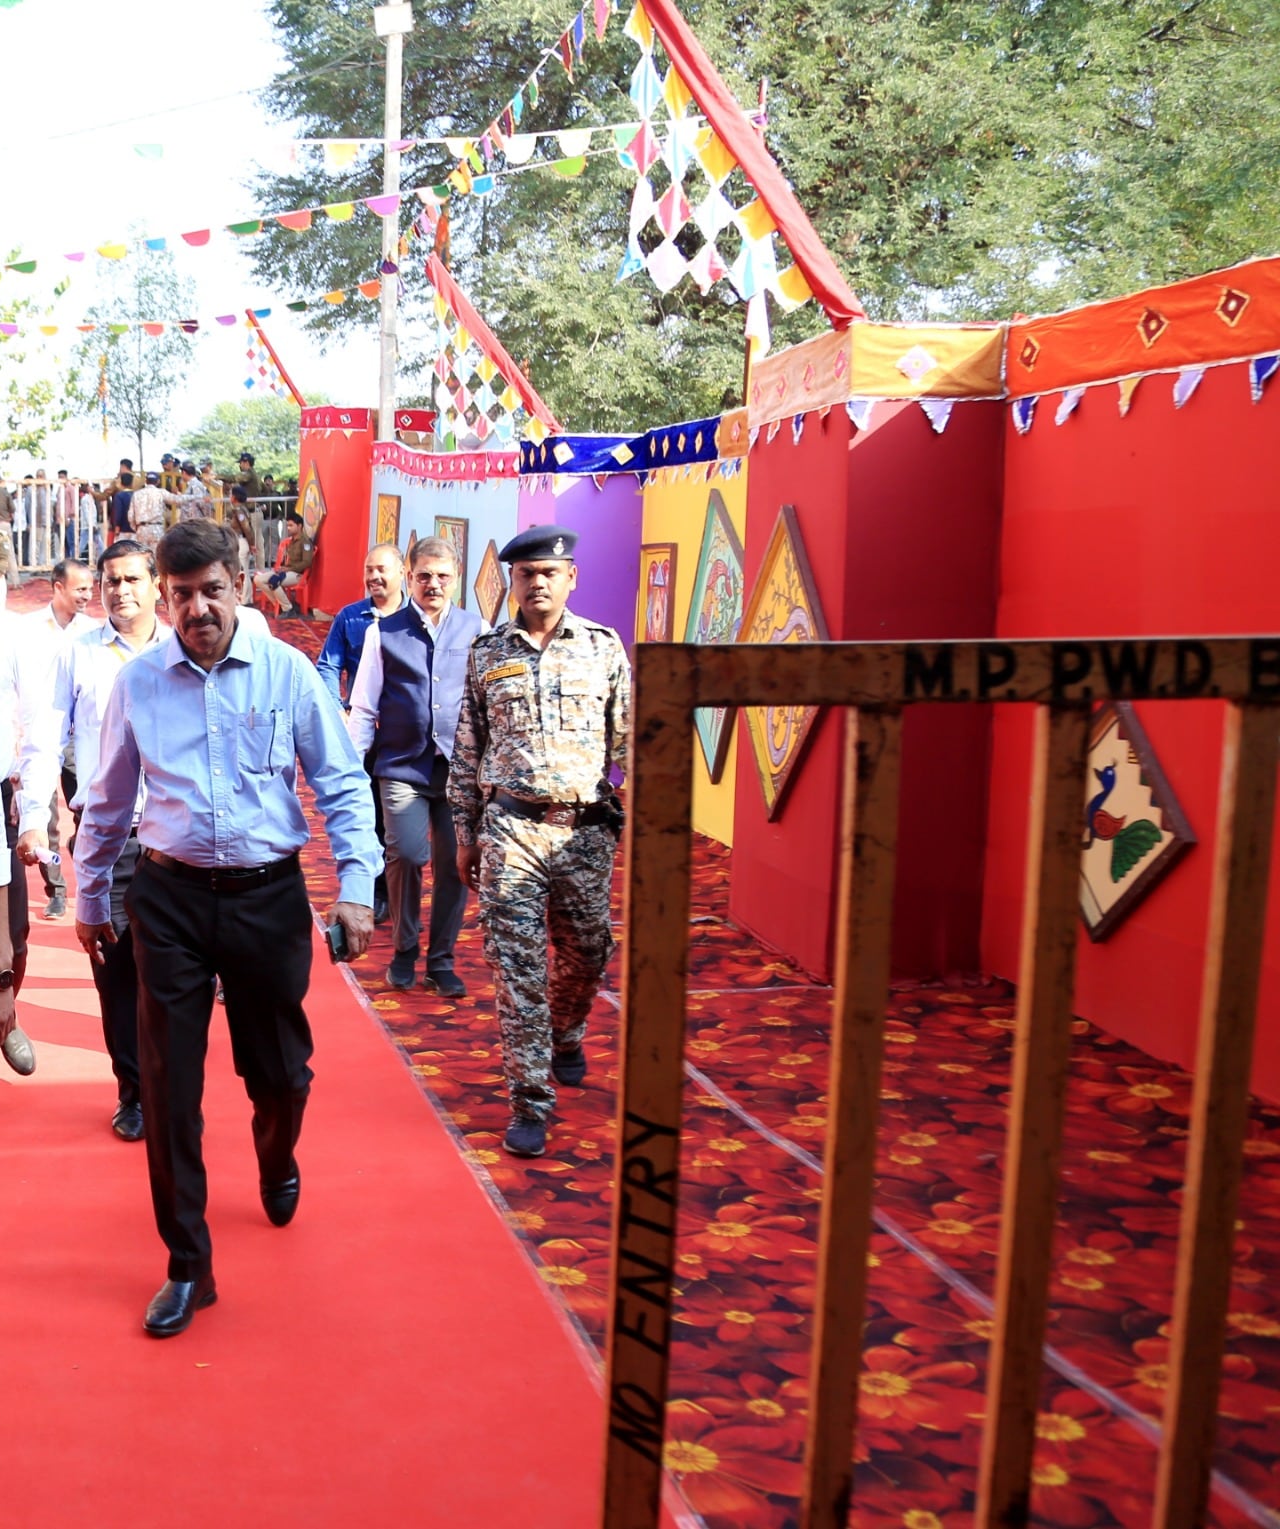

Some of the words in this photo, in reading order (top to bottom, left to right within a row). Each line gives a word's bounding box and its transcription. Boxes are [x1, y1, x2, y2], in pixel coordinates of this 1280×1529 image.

[903, 642, 1017, 699] M.P.
[1051, 640, 1221, 699] P.W.D.
[616, 1110, 679, 1357] ENTRY
[608, 1381, 663, 1465] NO
